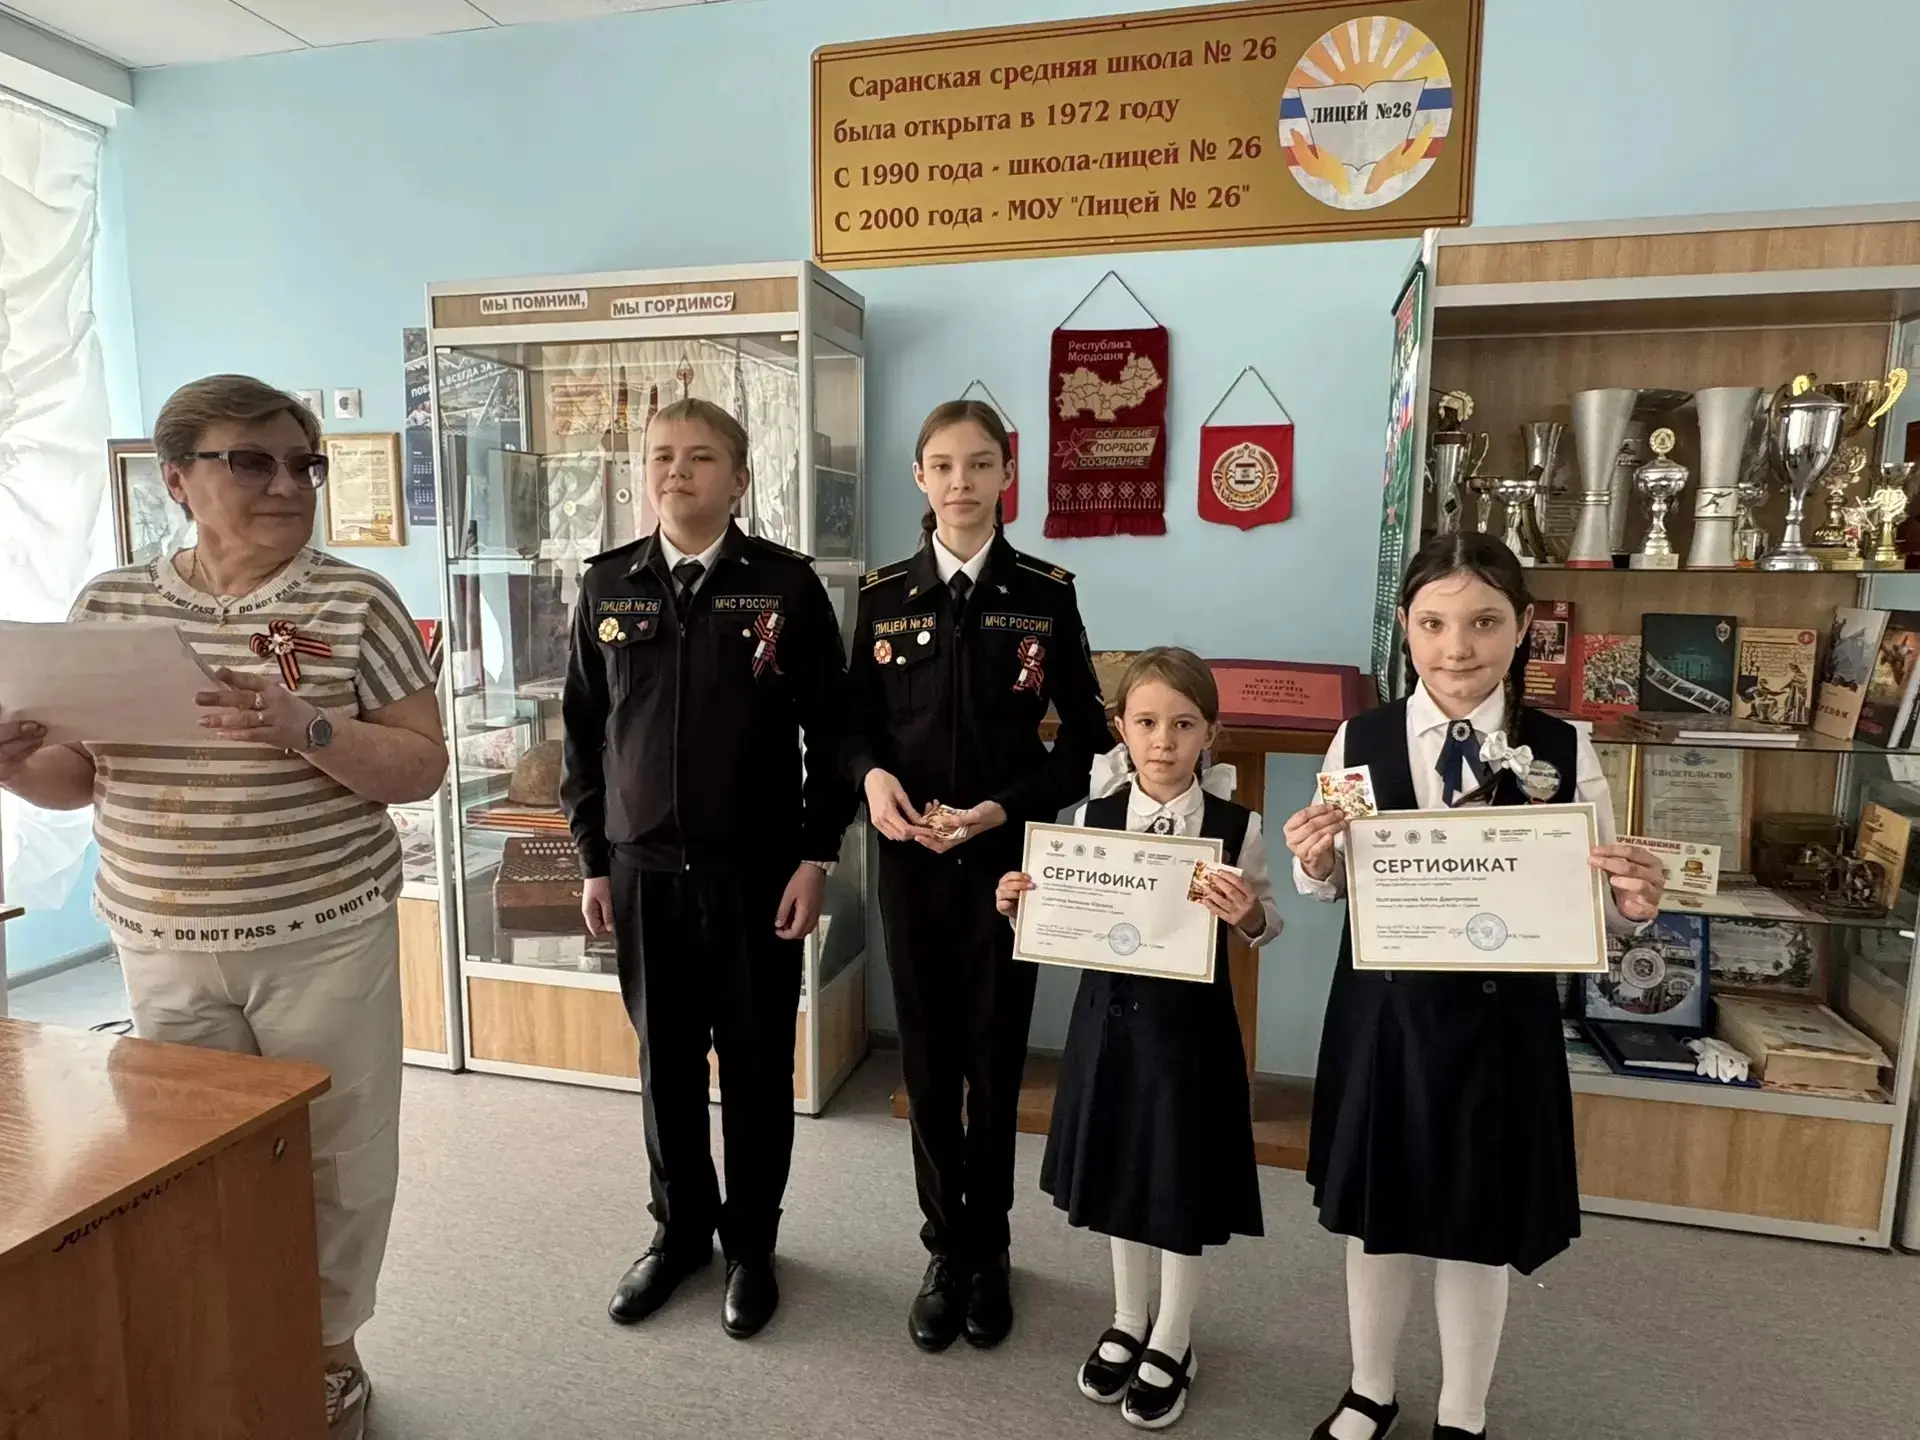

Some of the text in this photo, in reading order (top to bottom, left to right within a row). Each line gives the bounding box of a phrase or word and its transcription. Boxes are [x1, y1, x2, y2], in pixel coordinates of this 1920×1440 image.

[849, 36, 1277, 101] Саранская средняя школа № 26
[834, 98, 1180, 143] была открыта в 1972 году
[1310, 100, 1412, 124] ЛИЦЕЙ №26
[834, 167, 850, 188] С
[861, 162, 919, 187] 1990
[928, 160, 983, 185] года
[1008, 142, 1180, 176] школа-лицей
[1190, 138, 1217, 163] №
[1227, 136, 1262, 161] 26
[834, 211, 851, 232] С
[859, 206, 919, 231] 2000
[928, 205, 983, 231] года
[1007, 197, 1063, 222] МОУ
[1071, 190, 1160, 219] "Лицей
[1169, 187, 1197, 212] №
[1207, 184, 1250, 209] 26"
[482, 293, 732, 316] МЫ ПОМНИМ, МЫ ГОРДИМСЯ
[1067, 340, 1132, 362] Республика Мордовия
[446, 367, 479, 385] ВСЕГДА
[480, 362, 492, 373] ЗА
[1095, 429, 1153, 438] СОГЛАСИЕ
[1095, 442, 1149, 453] ПОРЯДОК
[1079, 457, 1145, 467] СОЗИДАНИЕ
[163, 591, 174, 602] DO
[191, 604, 216, 615] PASS
[239, 604, 253, 614] DO
[255, 596, 274, 610] NOT
[599, 598, 631, 612] ЛИЦЕЙ
[647, 601, 658, 612] 26
[715, 597, 779, 609] МЧС РОССИИ
[874, 618, 907, 636] ЛИЦЕЙ
[922, 616, 933, 628] 26
[985, 616, 1049, 632] МЧС РОССИИ
[1652, 769, 1732, 780] СВИДЕТЕЛЬСТВО
[1373, 857, 1518, 874] СЕРТИФИКАТ
[1043, 866, 1158, 892] СЕРТИФИКАТ
[315, 908, 337, 924] DO
[340, 898, 365, 916] NOT
[119, 915, 143, 934] PASS
[175, 924, 276, 941] DO NOT PASS
